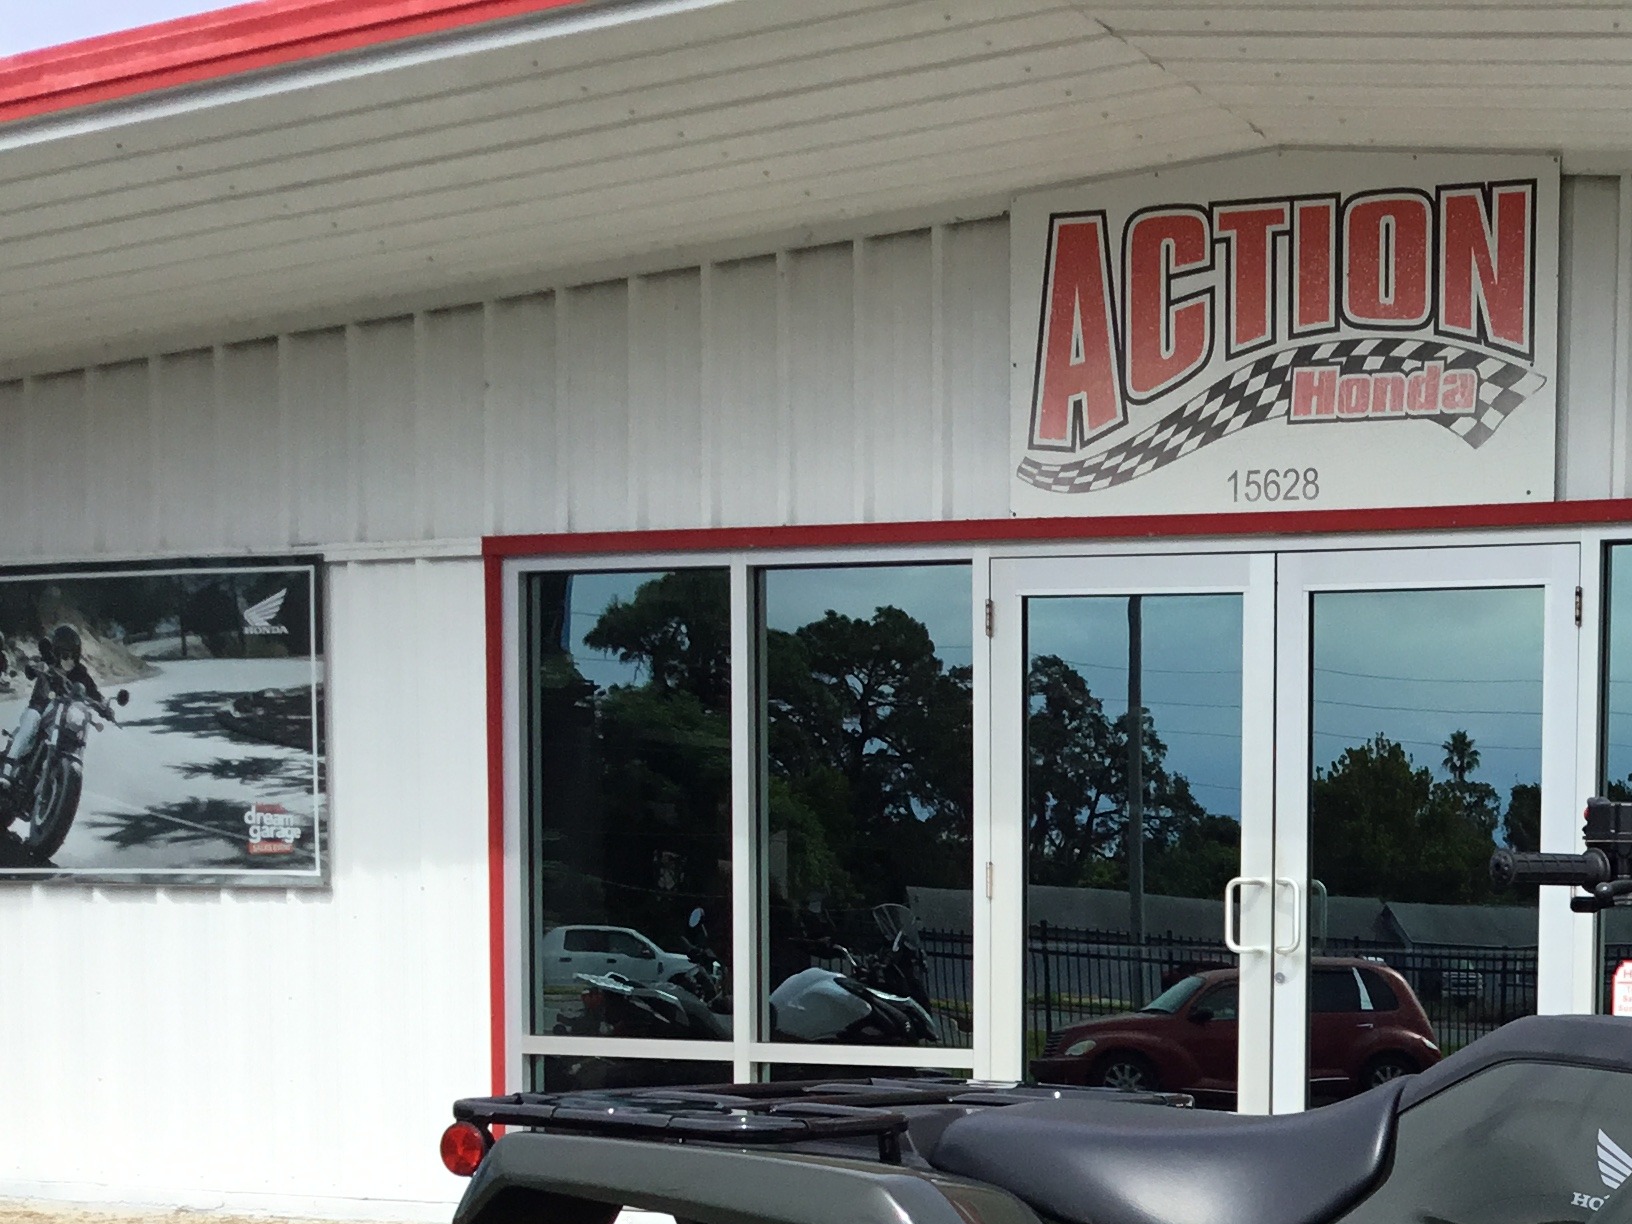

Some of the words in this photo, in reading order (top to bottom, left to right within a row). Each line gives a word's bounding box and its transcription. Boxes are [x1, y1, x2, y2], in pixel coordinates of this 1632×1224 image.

[1028, 178, 1538, 453] ACTION
[1288, 360, 1479, 424] Honda
[1227, 468, 1320, 502] 15628
[243, 625, 289, 635] HONDA
[244, 805, 294, 825] dream
[249, 826, 302, 844] garage
[1571, 1192, 1610, 1212] HO
